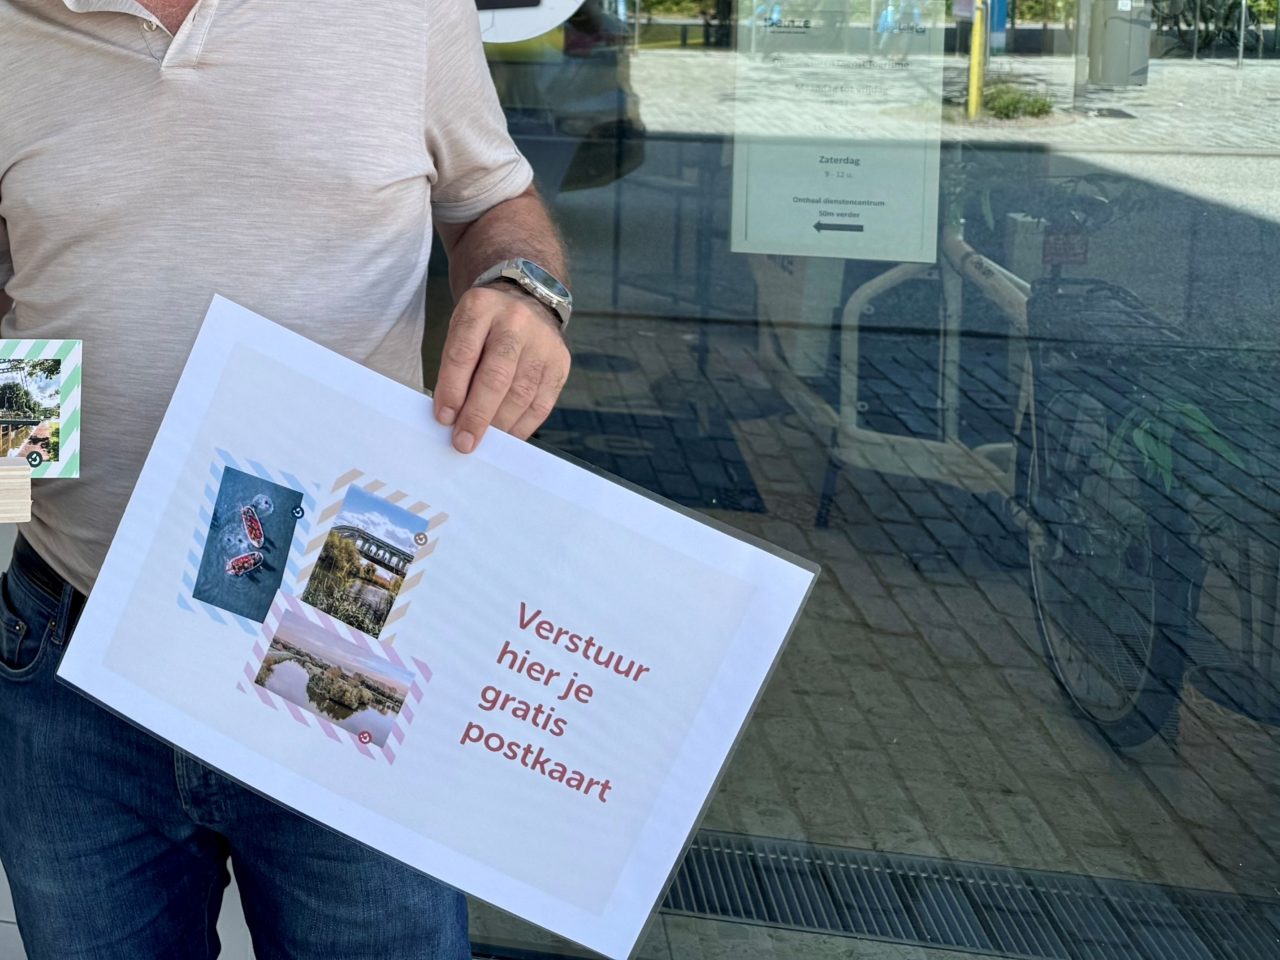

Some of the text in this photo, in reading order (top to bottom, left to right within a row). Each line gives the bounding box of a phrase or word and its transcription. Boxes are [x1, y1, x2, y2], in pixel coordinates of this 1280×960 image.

[818, 155, 861, 167] Zaterdag
[792, 196, 885, 207] Onthaal dienstencentrum
[517, 601, 650, 682] Verstuur
[496, 640, 594, 704] hier je
[478, 685, 568, 737] gratis
[460, 721, 612, 803] postkaart
